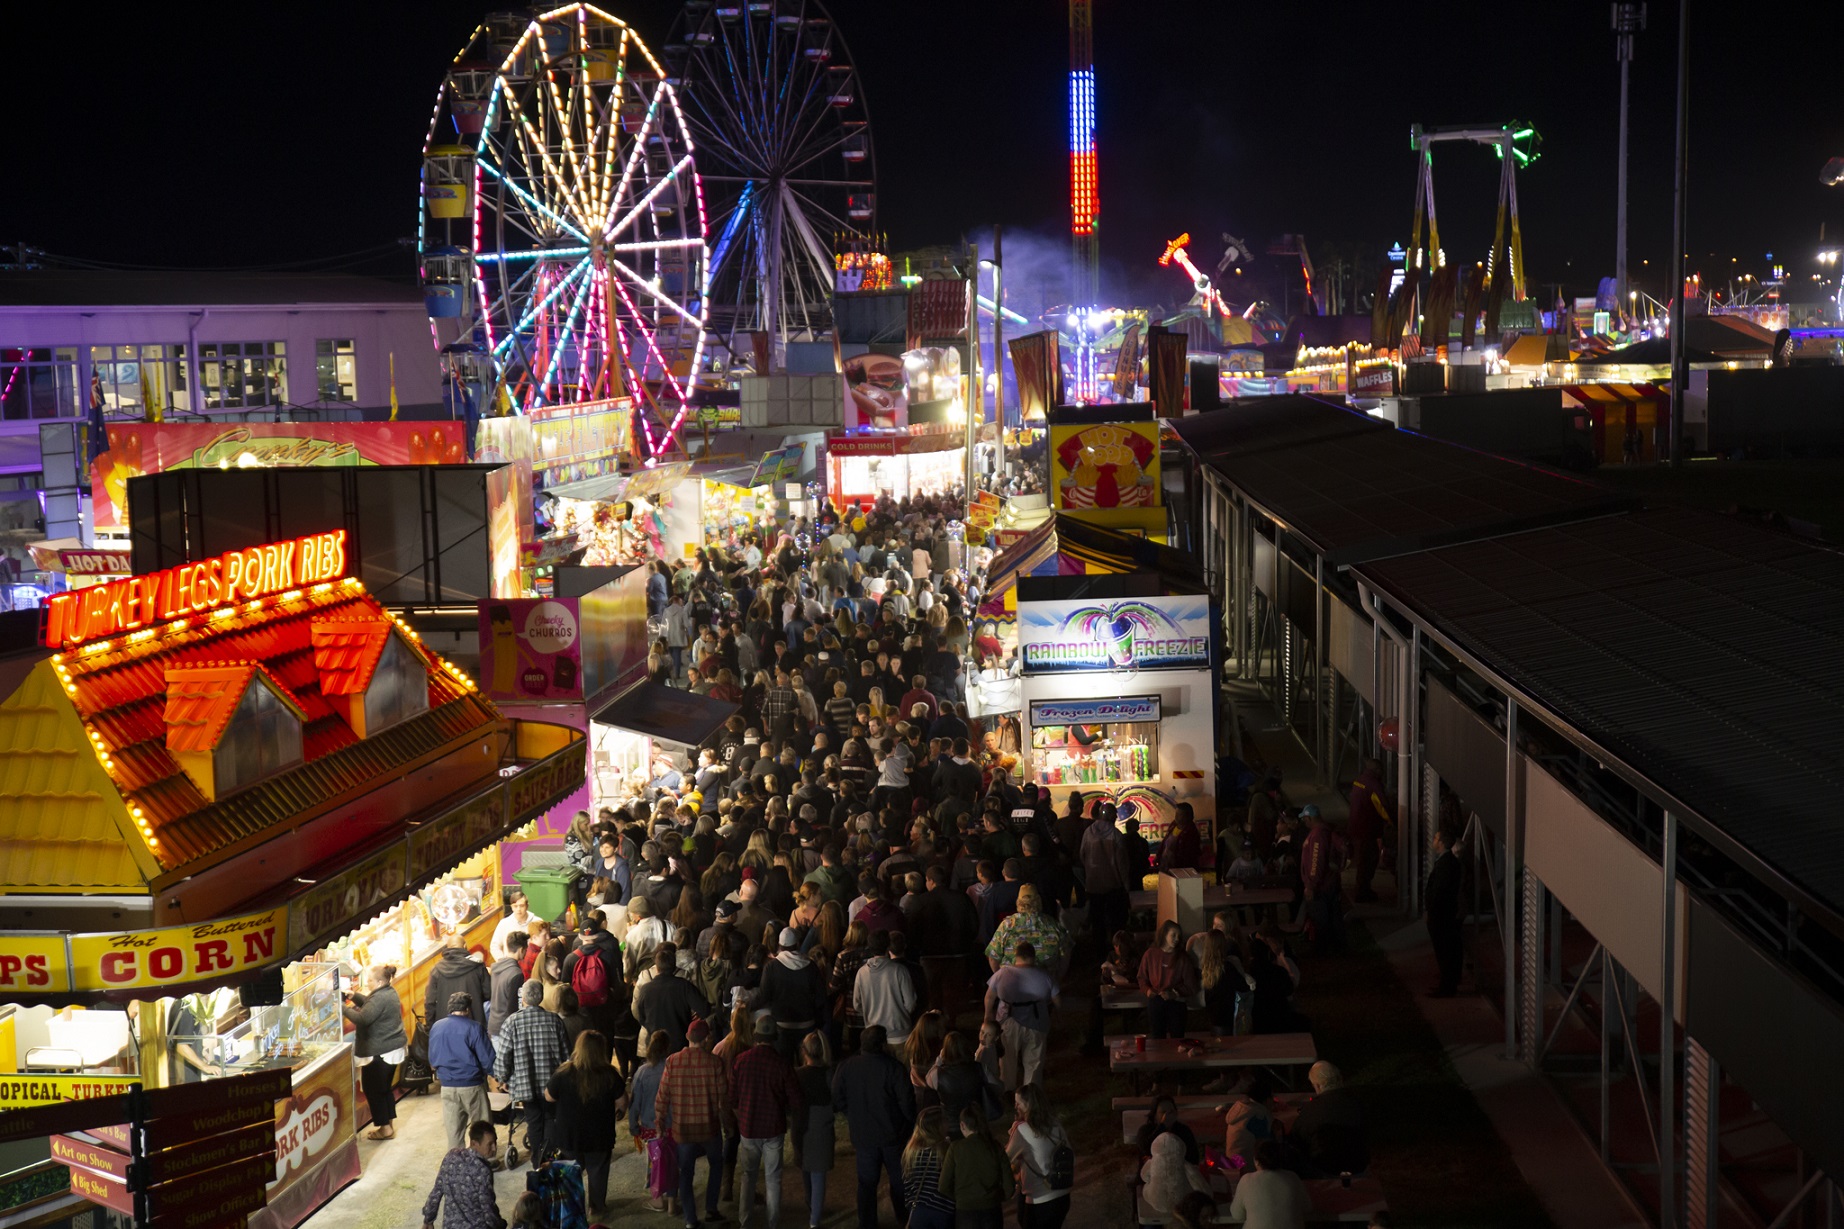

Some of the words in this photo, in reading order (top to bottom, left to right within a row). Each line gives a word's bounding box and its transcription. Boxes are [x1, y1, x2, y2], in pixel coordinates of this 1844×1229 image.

[1356, 371, 1393, 388] WAFFLES
[831, 442, 856, 451] COLD
[858, 442, 893, 451] DRINKS
[1077, 425, 1133, 449] HOT
[1077, 444, 1135, 466] FOOD
[67, 554, 104, 572] HOT
[104, 555, 131, 571] DA
[46, 570, 160, 648] TURKEY
[158, 557, 224, 620] LEGS
[224, 540, 297, 601] PORK
[298, 528, 347, 584] RIBS
[529, 627, 572, 638] CHURROS
[1028, 642, 1108, 660] RAINBOW
[1135, 638, 1206, 657] FREEZIE
[524, 674, 545, 682] ORDER
[1040, 708, 1094, 718] Frozen
[1098, 704, 1152, 716] Delight
[513, 757, 582, 815] SAUSAGES
[1140, 822, 1209, 841] FREE
[109, 935, 158, 948] Hot
[192, 911, 275, 939] Buttered
[100, 926, 275, 983] CORN
[227, 1081, 277, 1099] Horses
[192, 1104, 262, 1132] Woodchop
[275, 1125, 299, 1162] ORK
[302, 1102, 330, 1142] RIBS
[61, 1144, 74, 1159] Art
[76, 1151, 88, 1163] on
[89, 1153, 113, 1171] Show
[163, 1143, 236, 1173] Stockmen's
[239, 1136, 261, 1151] Bar
[78, 1175, 90, 1193] Big
[91, 1179, 108, 1198] Shed
[160, 1187, 195, 1207] Sugar
[200, 1170, 244, 1195] Display
[184, 1209, 218, 1229] Show
[220, 1192, 256, 1214] Office
